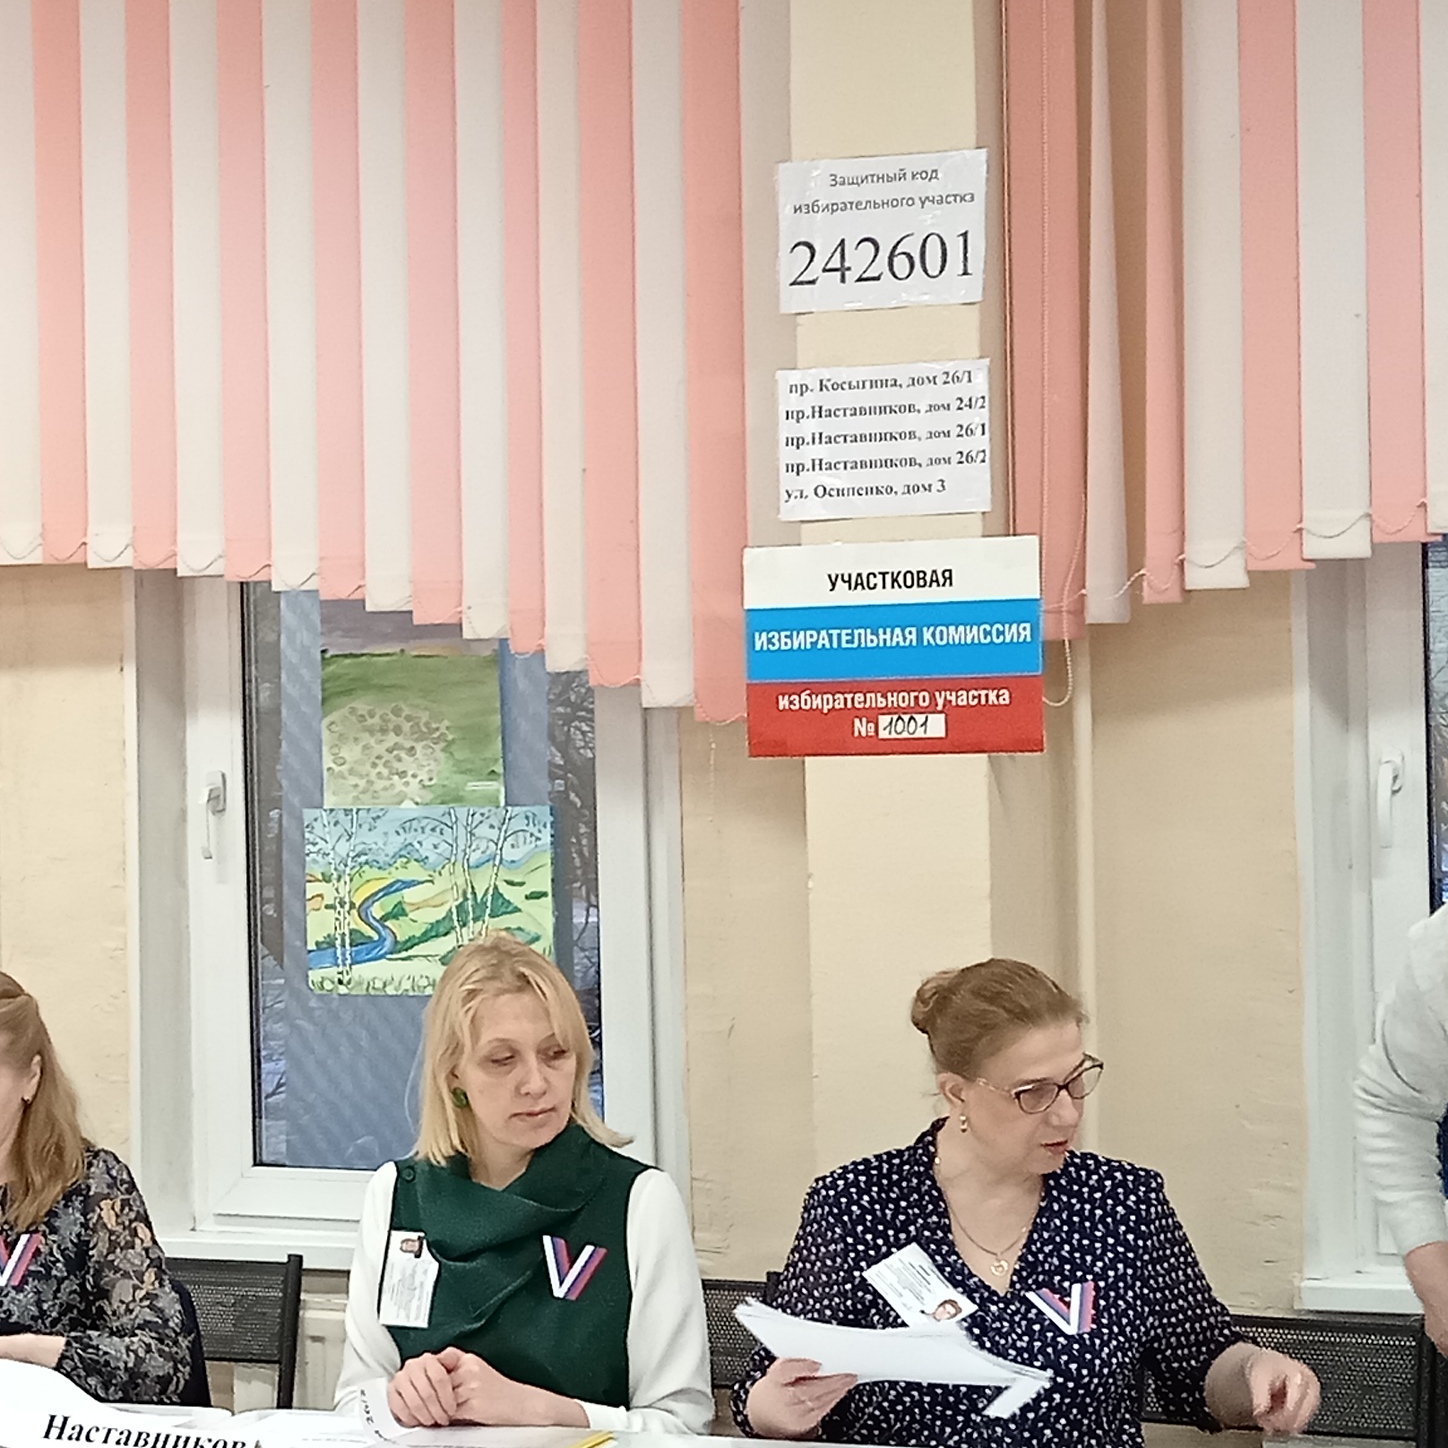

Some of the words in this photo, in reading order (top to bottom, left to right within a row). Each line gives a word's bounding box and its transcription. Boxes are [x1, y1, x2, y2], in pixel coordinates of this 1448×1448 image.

[829, 168, 907, 187] Защитный
[911, 168, 940, 182] код
[793, 195, 915, 215] избирательного
[918, 192, 975, 209] участка
[788, 229, 973, 287] 242601
[818, 377, 903, 393] Косыгина,
[906, 374, 938, 388] дом
[941, 370, 973, 386] 26/1
[924, 403, 952, 415] дом
[955, 395, 987, 411] 24/2
[924, 429, 952, 441] дом
[955, 423, 987, 438] 26/1
[925, 456, 952, 468] дом
[955, 449, 987, 465] 26/2
[901, 482, 933, 496] дом
[936, 479, 947, 493] 3
[826, 568, 954, 592] УЧАСТКОВАЯ
[754, 626, 917, 652] ИЗБИРАТЕЛЬНАЯ
[923, 622, 1032, 647] КОМИССИЯ
[777, 690, 930, 713] избирательного
[935, 688, 1010, 710] участка
[853, 717, 875, 737] №
[882, 715, 929, 736] 1001
